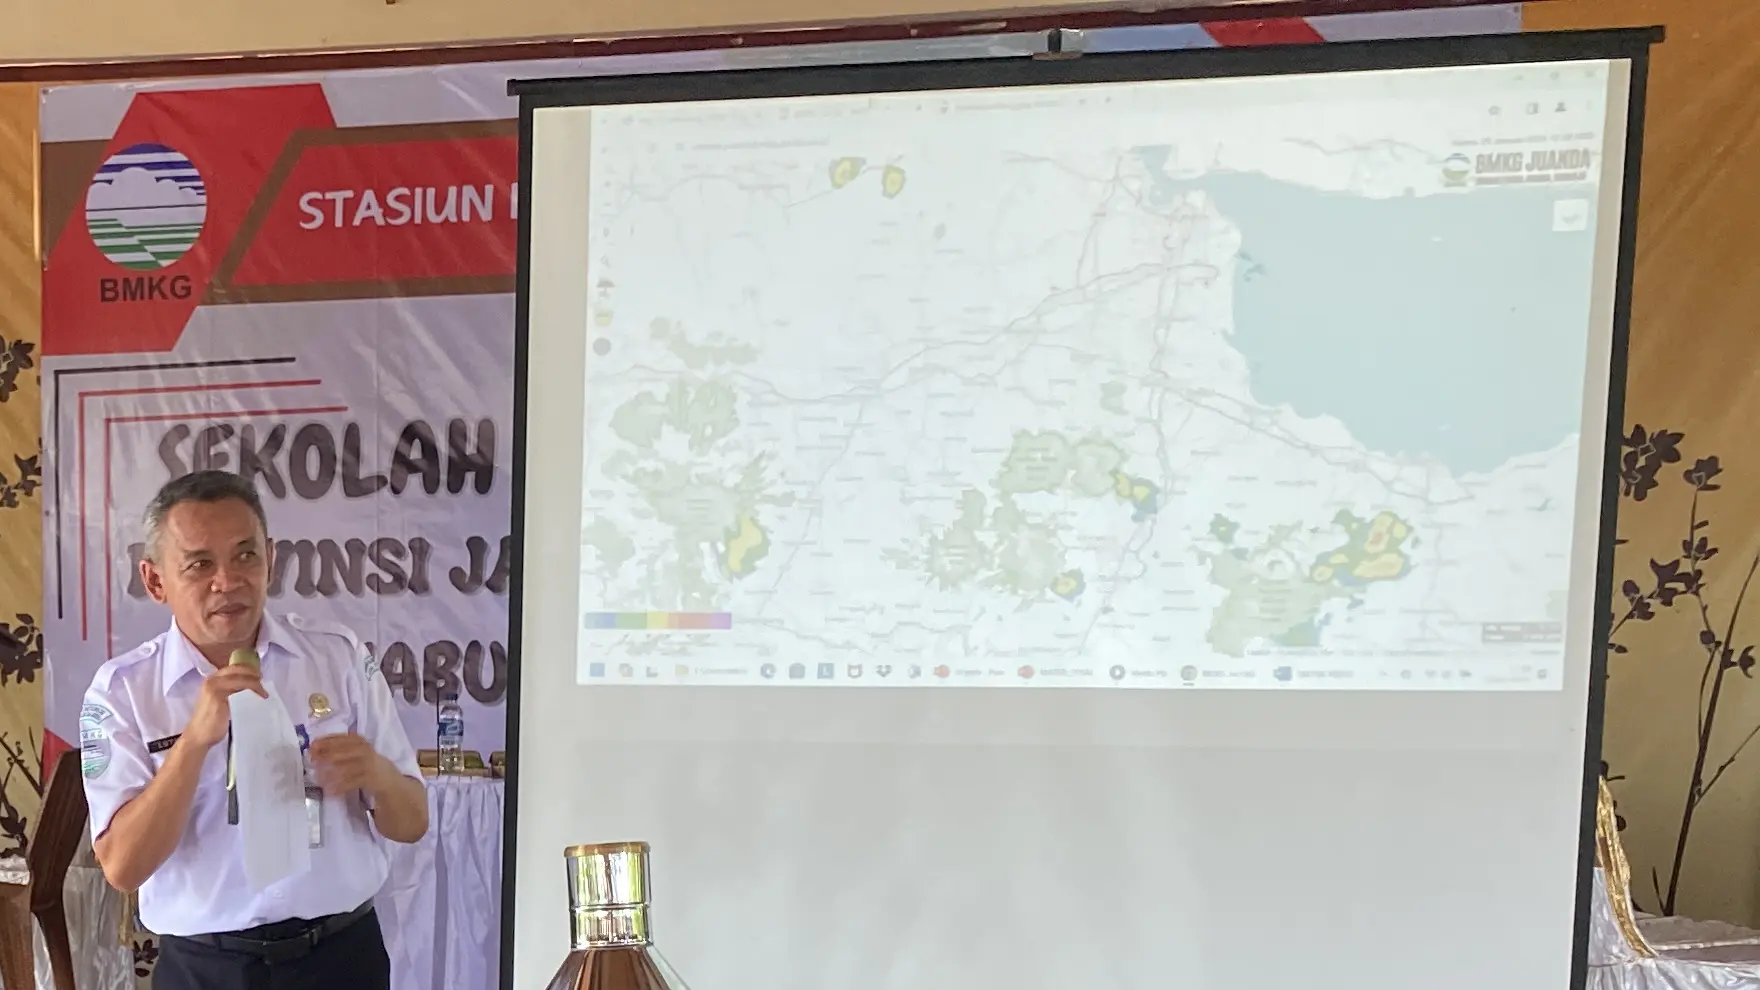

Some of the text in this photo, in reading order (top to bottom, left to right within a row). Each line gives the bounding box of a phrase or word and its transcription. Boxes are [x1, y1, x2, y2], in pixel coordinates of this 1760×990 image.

[299, 184, 494, 230] STASIUN
[101, 275, 193, 303] BMKG
[158, 418, 496, 499] SEKOLAH
[364, 640, 508, 707] ABU
